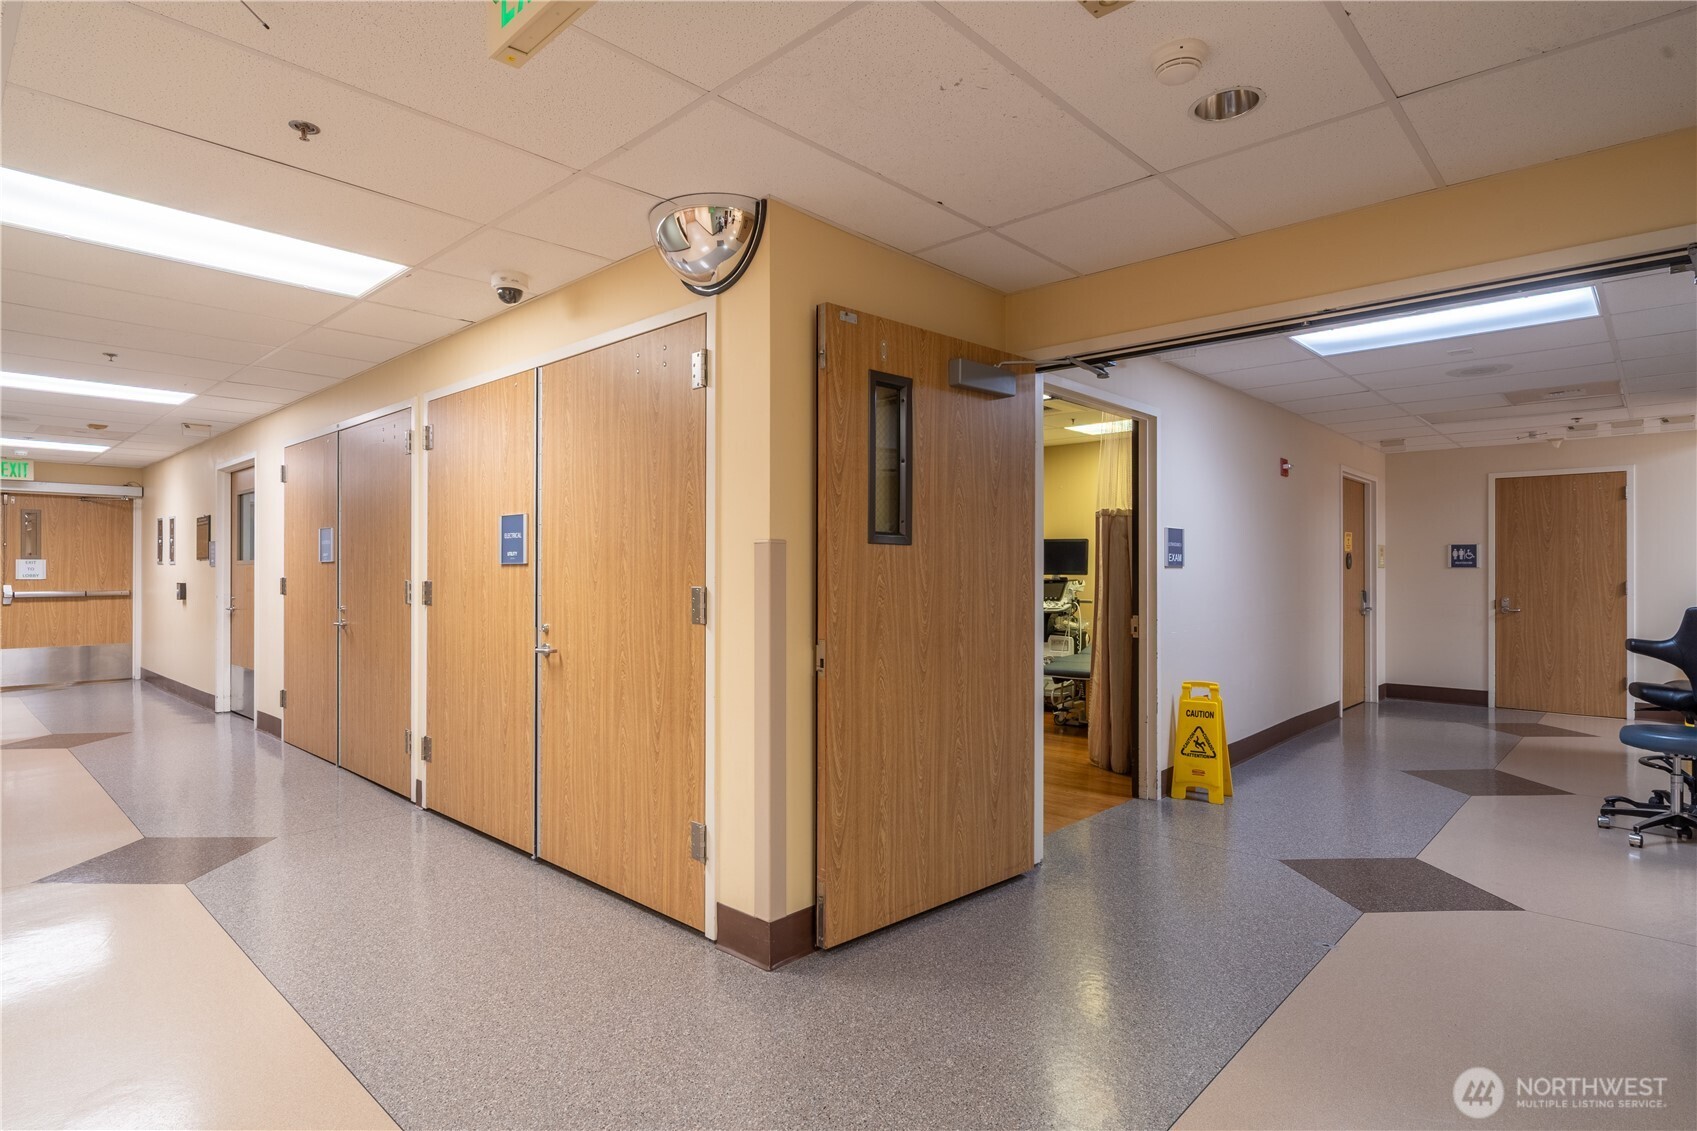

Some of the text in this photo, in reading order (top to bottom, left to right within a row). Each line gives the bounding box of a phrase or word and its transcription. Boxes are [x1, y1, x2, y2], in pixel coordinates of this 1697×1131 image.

[1, 461, 29, 478] EXIT
[1168, 553, 1183, 562] EXAM
[1185, 709, 1215, 719] CAUTION
